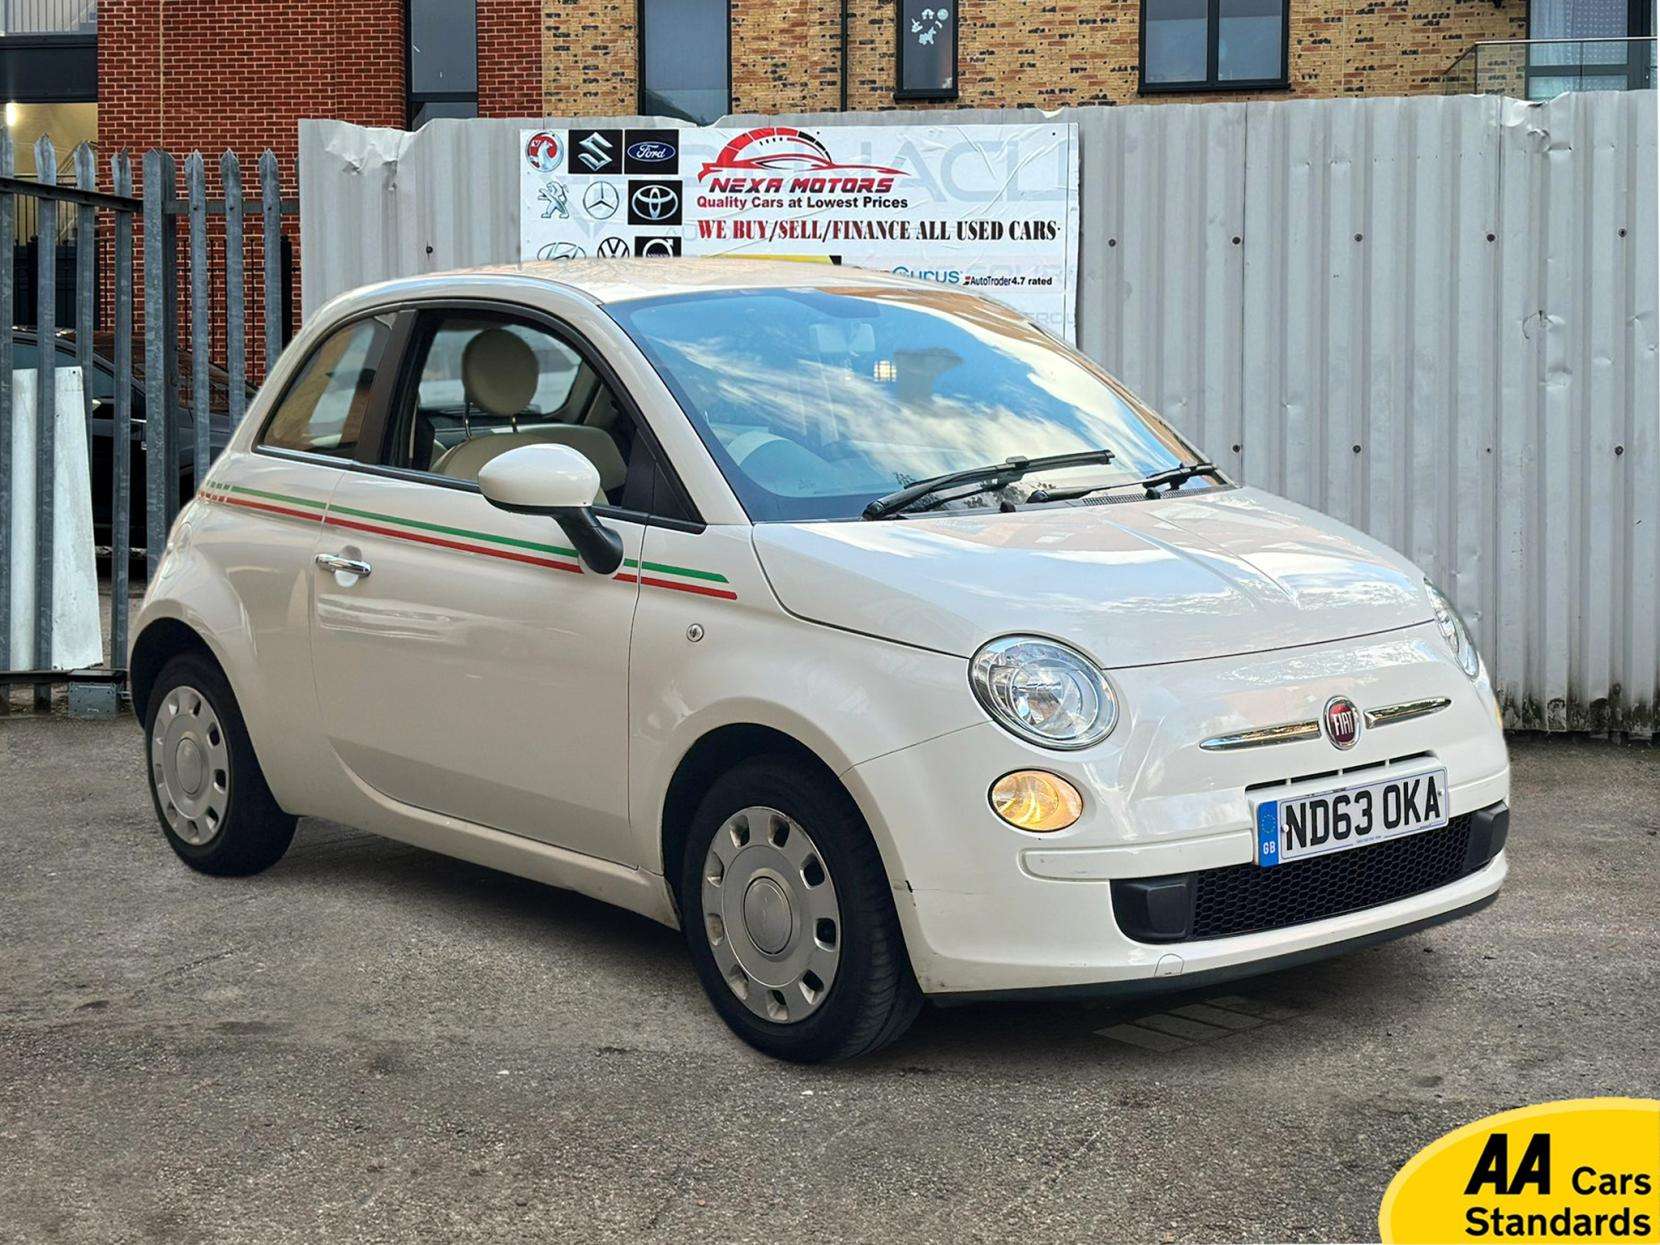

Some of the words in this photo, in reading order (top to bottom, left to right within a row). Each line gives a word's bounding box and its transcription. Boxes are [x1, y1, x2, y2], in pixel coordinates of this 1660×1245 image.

[636, 144, 665, 158] Ford
[708, 177, 781, 193] NEXA
[789, 177, 894, 193] MOTORS
[697, 196, 747, 210] Quality
[752, 196, 784, 208] Cars
[788, 197, 803, 208] at
[807, 196, 858, 208] Lowest
[863, 196, 908, 208] Prices
[697, 219, 727, 239] WE
[916, 220, 950, 241] ALL
[957, 220, 1003, 241] USED
[1008, 220, 1057, 241] CARS
[1028, 277, 1052, 286] rated
[1333, 711, 1354, 736] FIAT
[1286, 790, 1373, 850] ND63
[1383, 776, 1440, 830] OKA
[1263, 841, 1276, 855] GB
